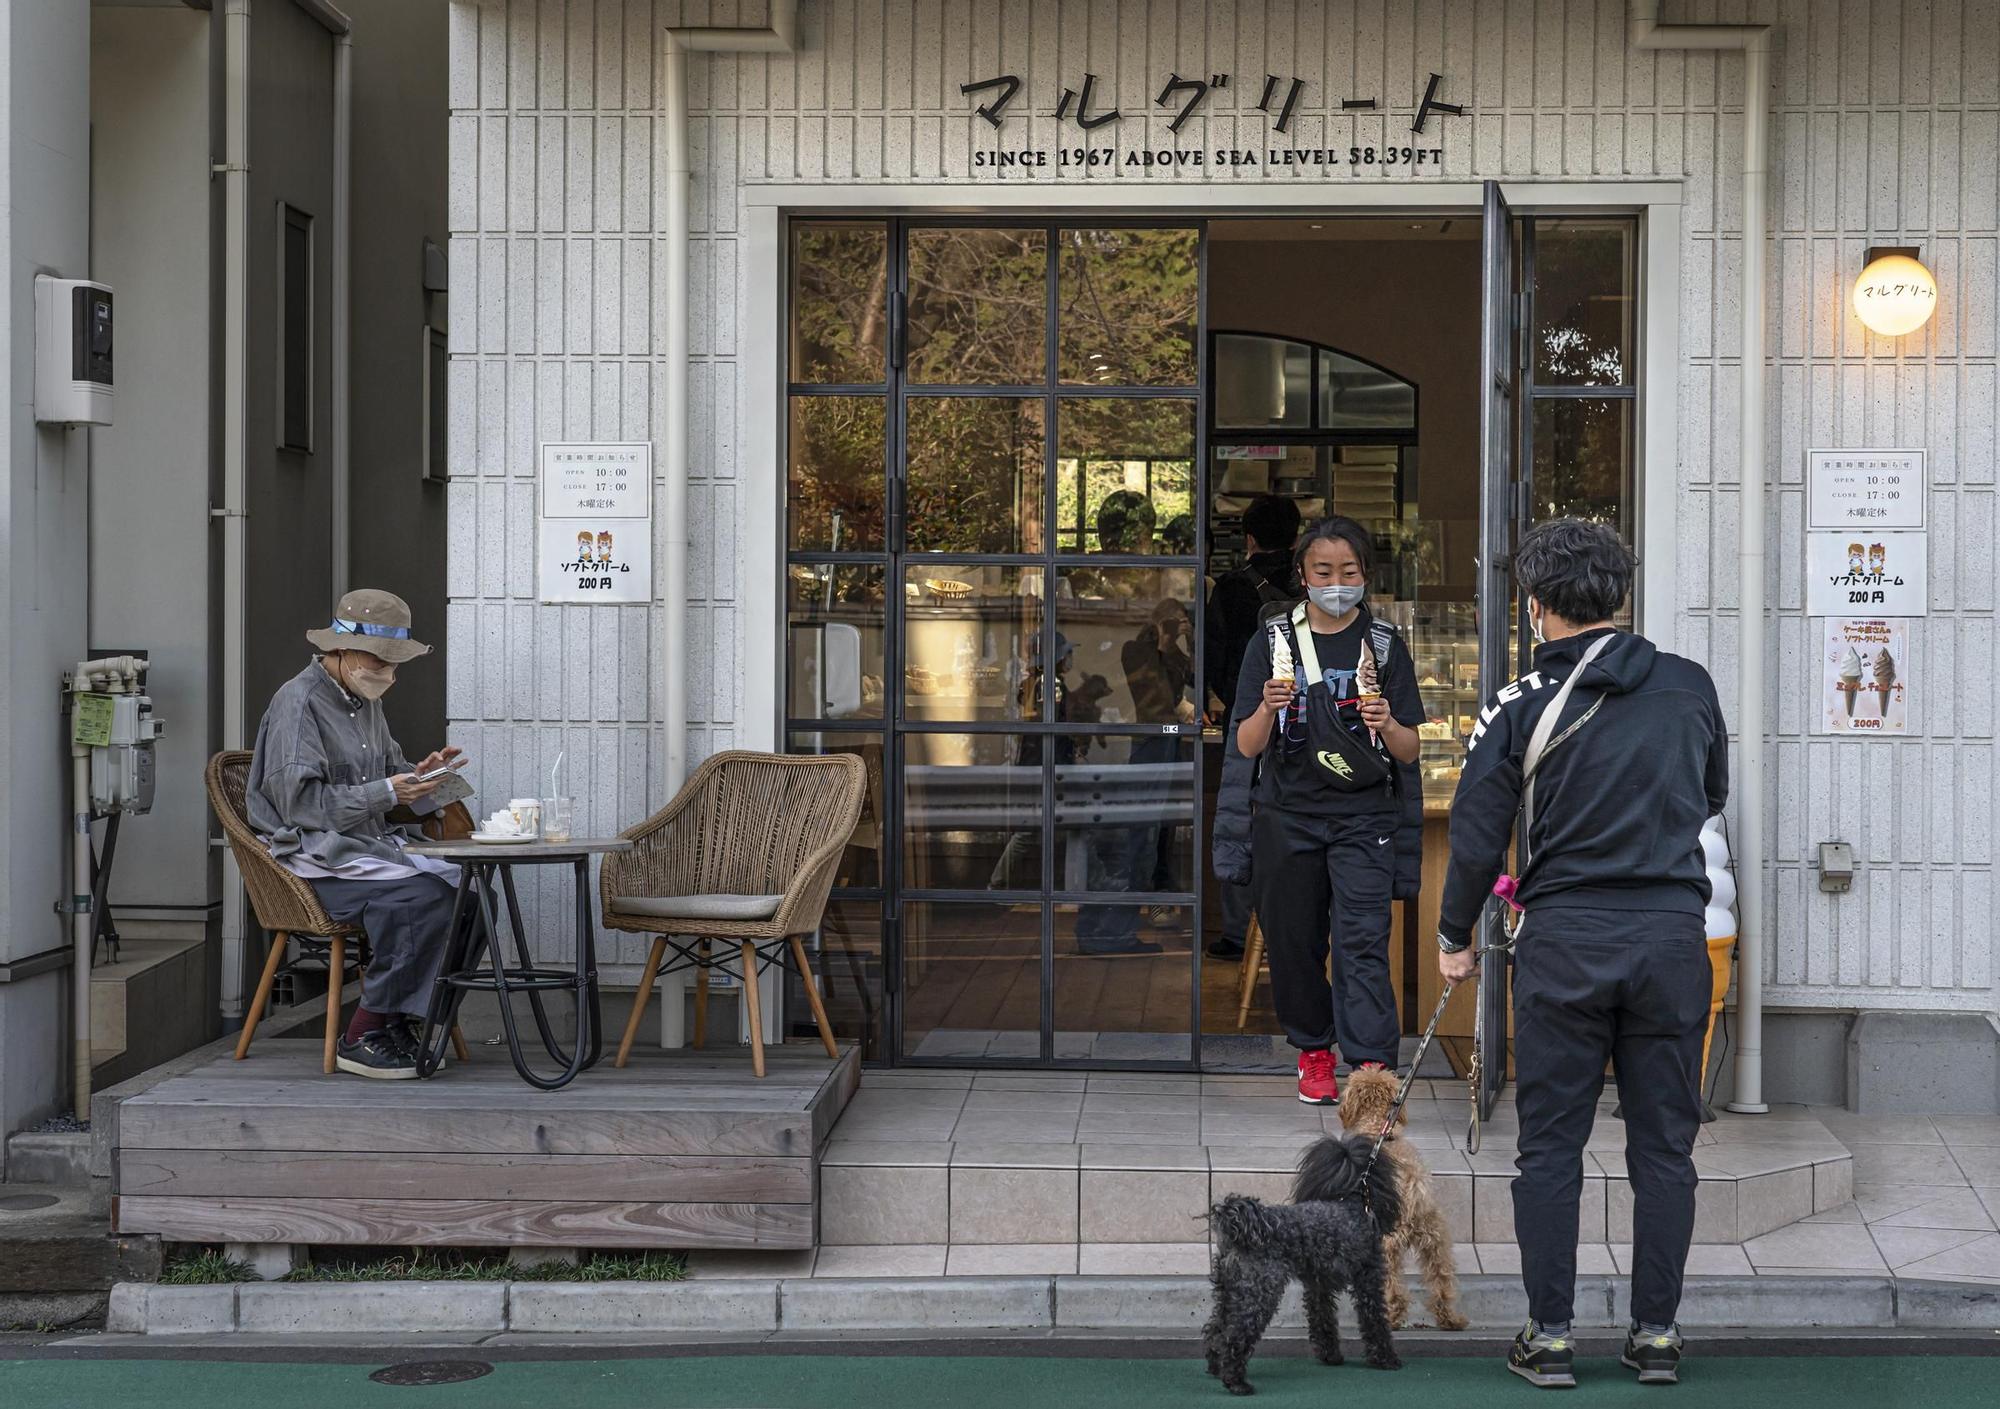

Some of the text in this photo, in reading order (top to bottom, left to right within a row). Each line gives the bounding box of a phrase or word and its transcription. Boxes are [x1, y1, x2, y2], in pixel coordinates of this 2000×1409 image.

[960, 73, 1463, 134] マルグリート
[975, 147, 1443, 167] SINCE 1967 ABOVE SEA LEVEL 58.39FT
[1863, 284, 1934, 298] マルグリート
[577, 498, 615, 509] 木曜定休
[1846, 507, 1887, 518] 木曜定休
[560, 562, 630, 572] ソフトクリーム
[1829, 575, 1904, 586] ソフトクリーム
[1844, 635, 1890, 643] ソフトクリーム
[1853, 719, 1880, 728] 200円
[1327, 752, 1354, 777] NIKE
